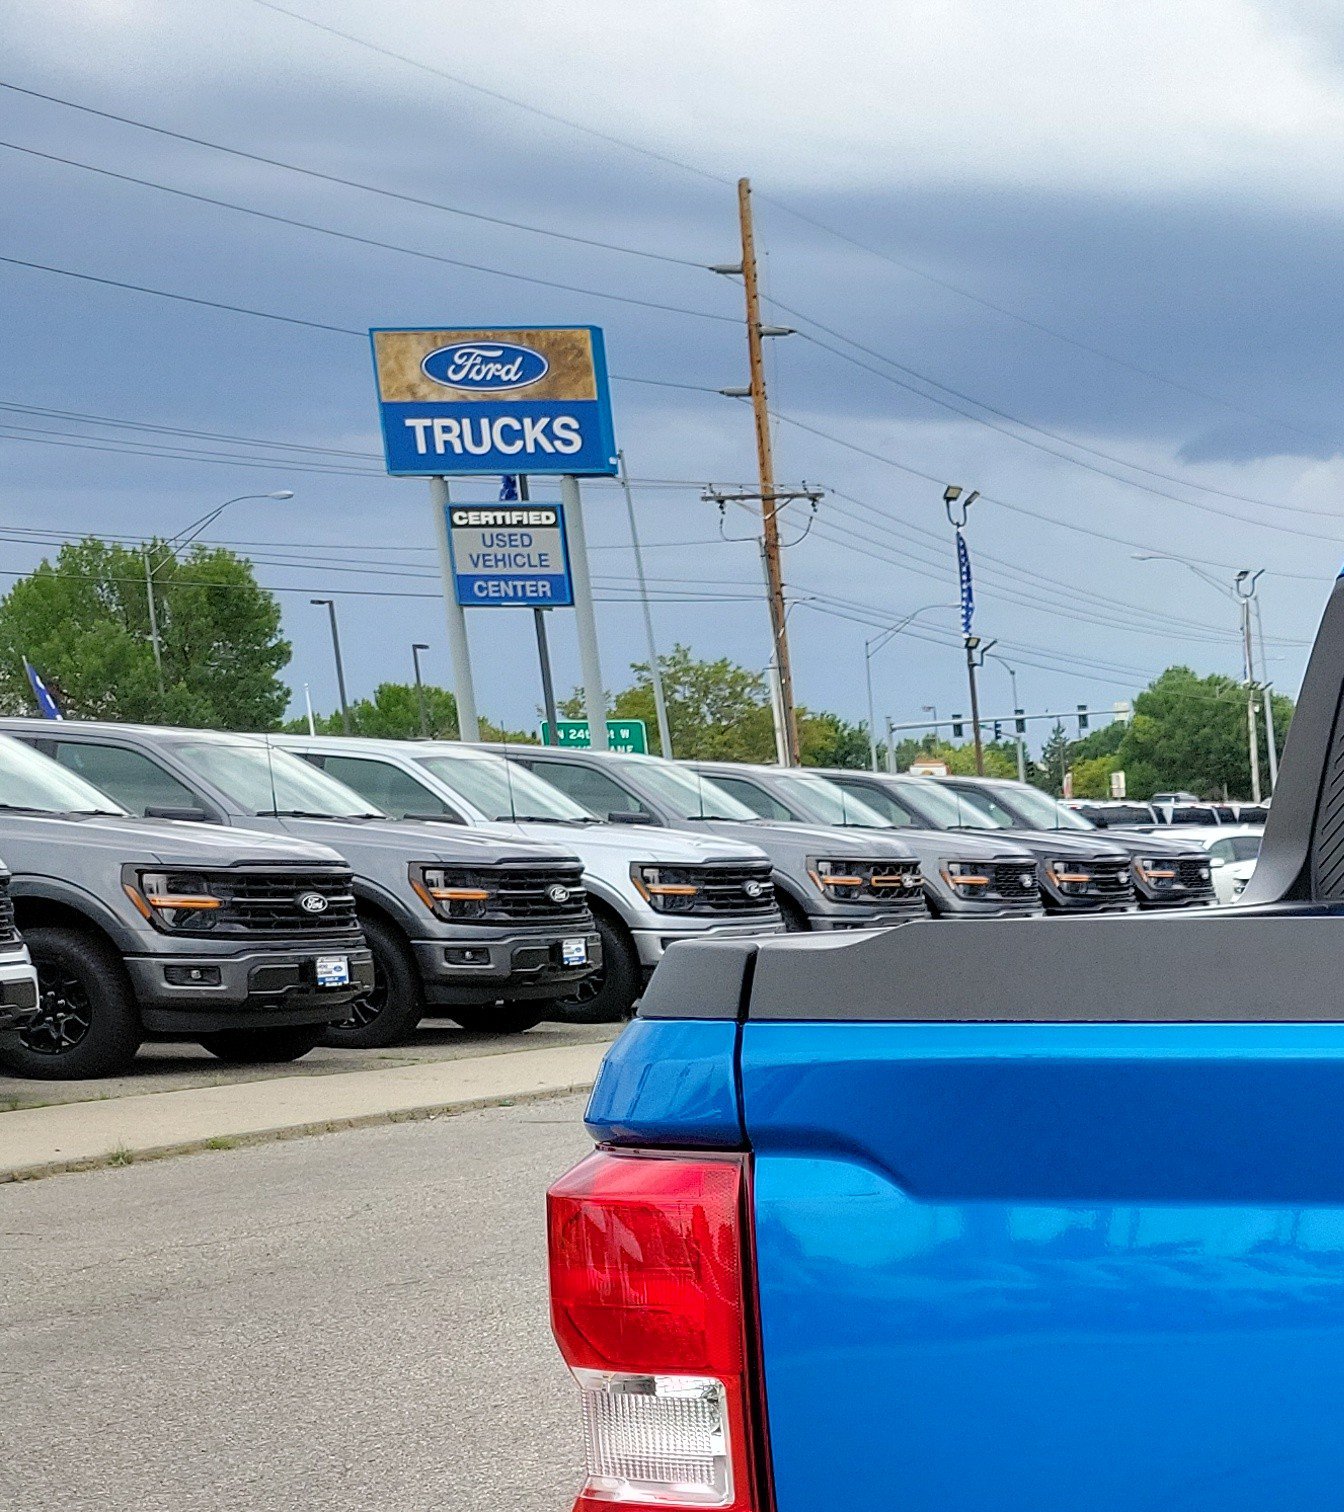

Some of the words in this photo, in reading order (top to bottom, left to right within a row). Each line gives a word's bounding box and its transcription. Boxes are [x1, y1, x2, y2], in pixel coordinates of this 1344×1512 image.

[447, 348, 524, 382] Ford
[405, 416, 583, 454] TRUCKS
[452, 510, 556, 526] CERTIFIED
[481, 532, 533, 549] USED
[468, 552, 551, 569] VEHICLE
[473, 580, 552, 598] CENTER
[569, 728, 591, 740] 24t
